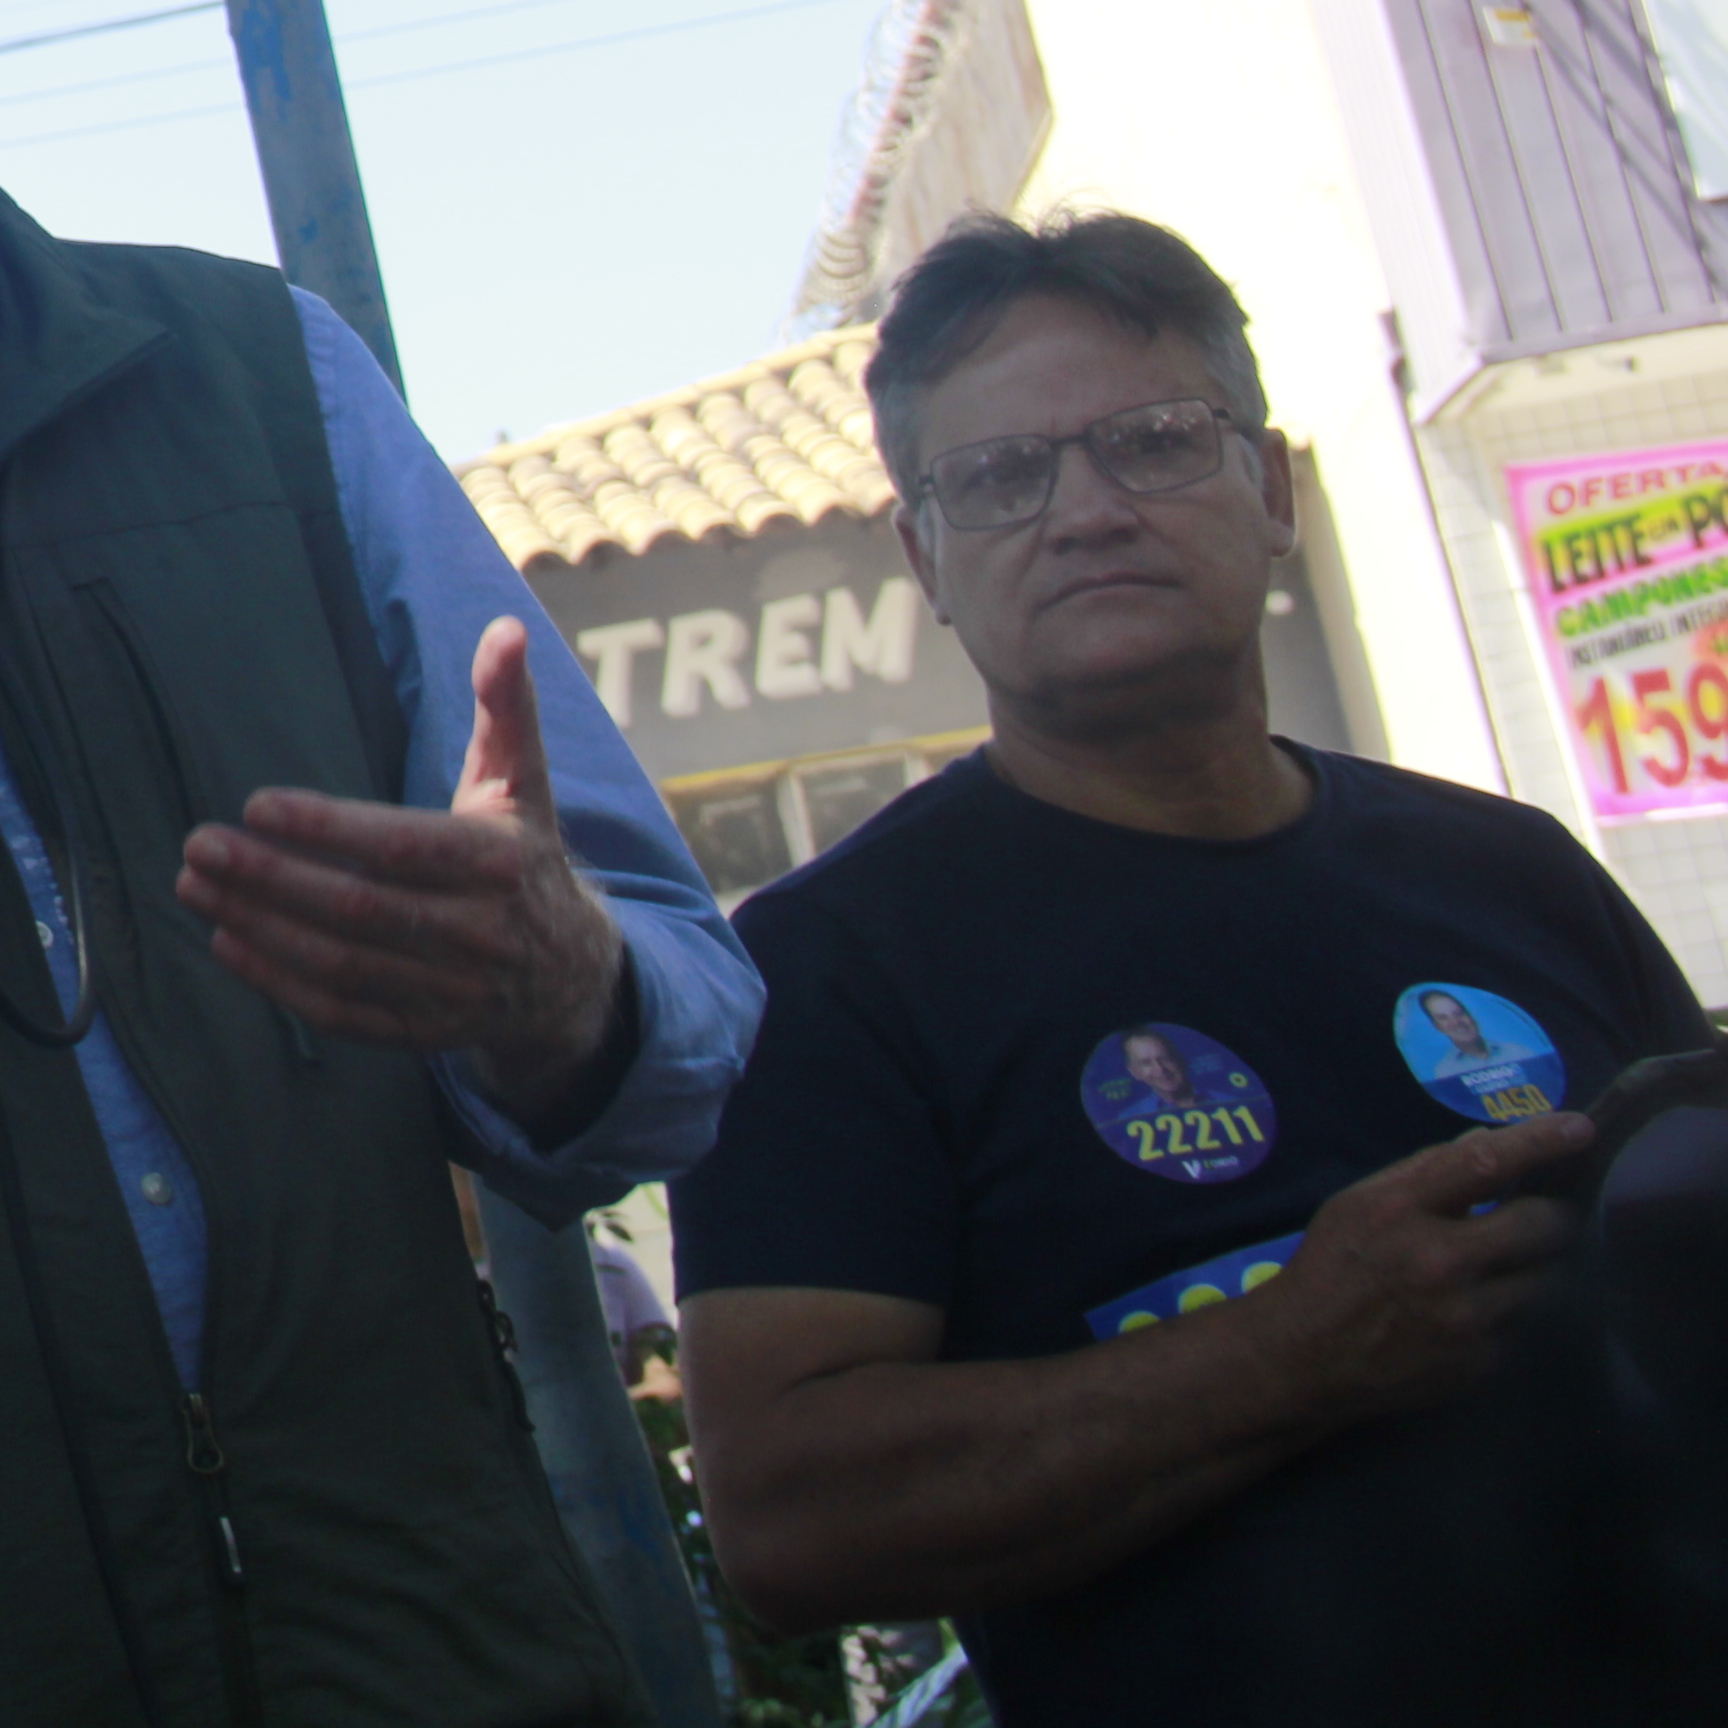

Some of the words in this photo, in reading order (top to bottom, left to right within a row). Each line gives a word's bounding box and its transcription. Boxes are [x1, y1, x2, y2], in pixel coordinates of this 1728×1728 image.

[1542, 514, 1654, 594] LEITE
[575, 576, 922, 728] TREM
[1126, 1105, 1266, 1161] 22211
